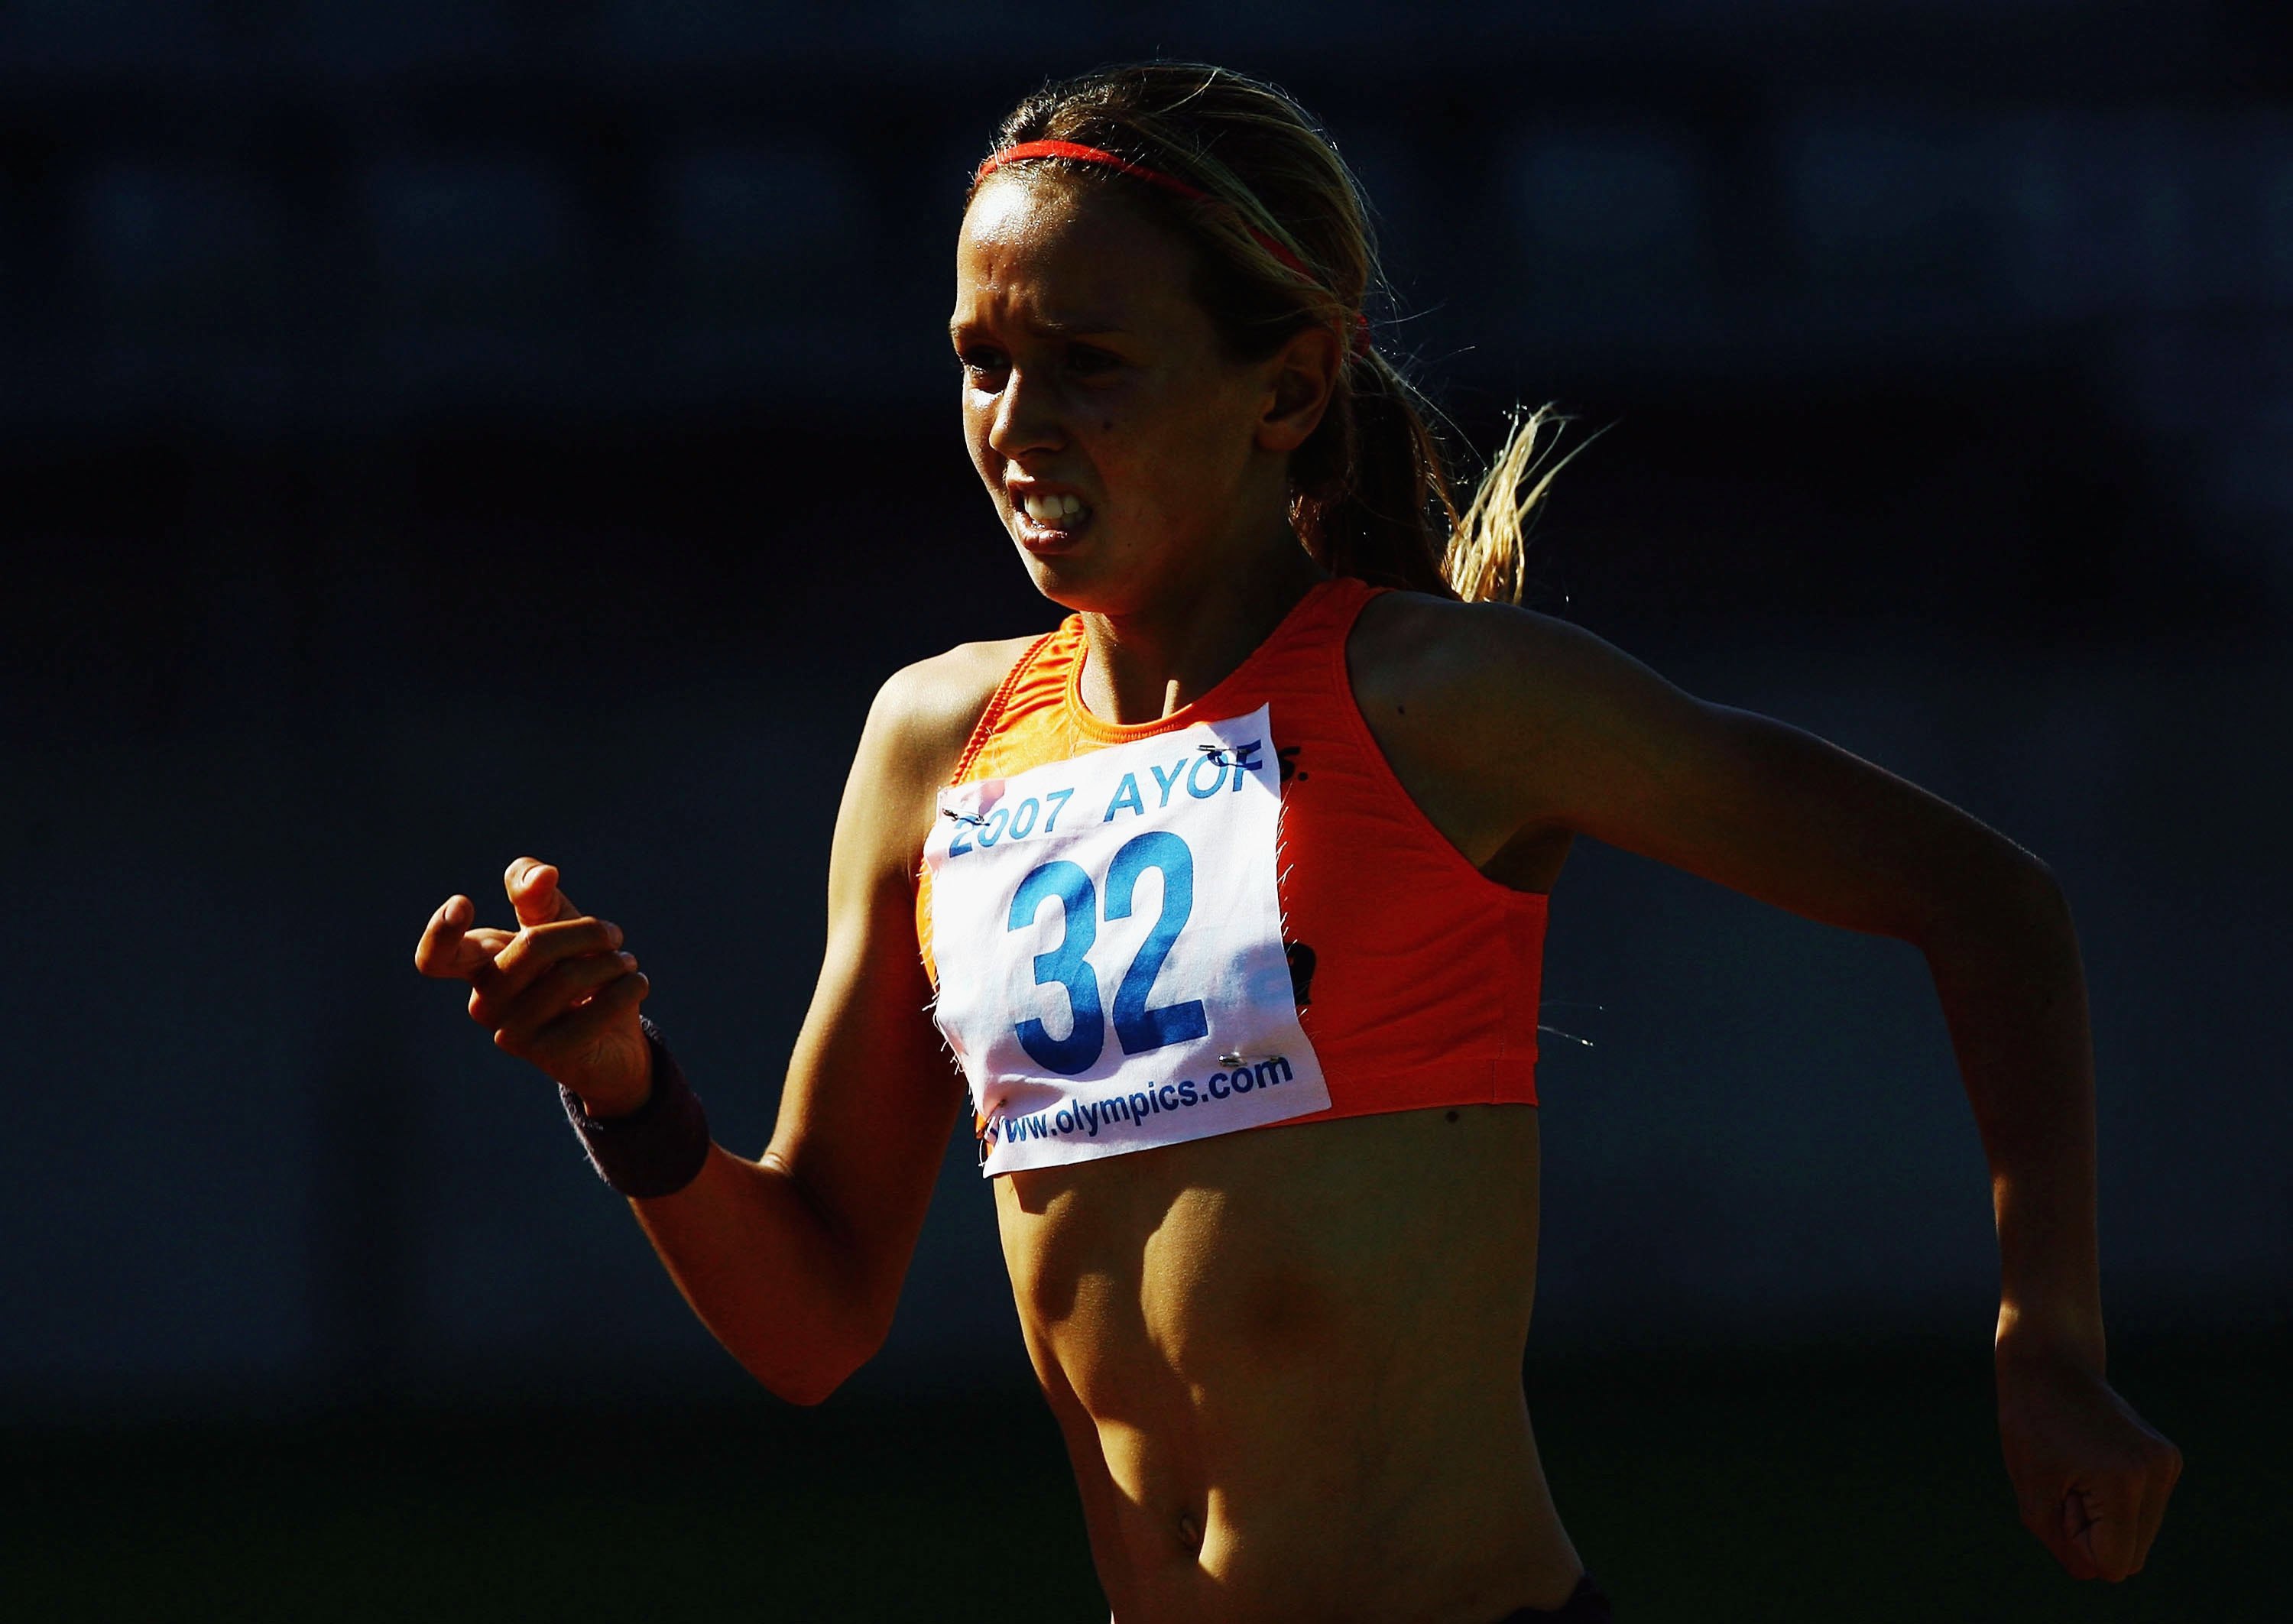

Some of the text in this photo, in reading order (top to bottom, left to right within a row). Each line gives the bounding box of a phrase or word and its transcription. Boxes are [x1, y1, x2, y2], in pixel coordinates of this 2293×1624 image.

[949, 739, 1263, 858] 2007 AYOF
[1007, 831, 1208, 1075] 32
